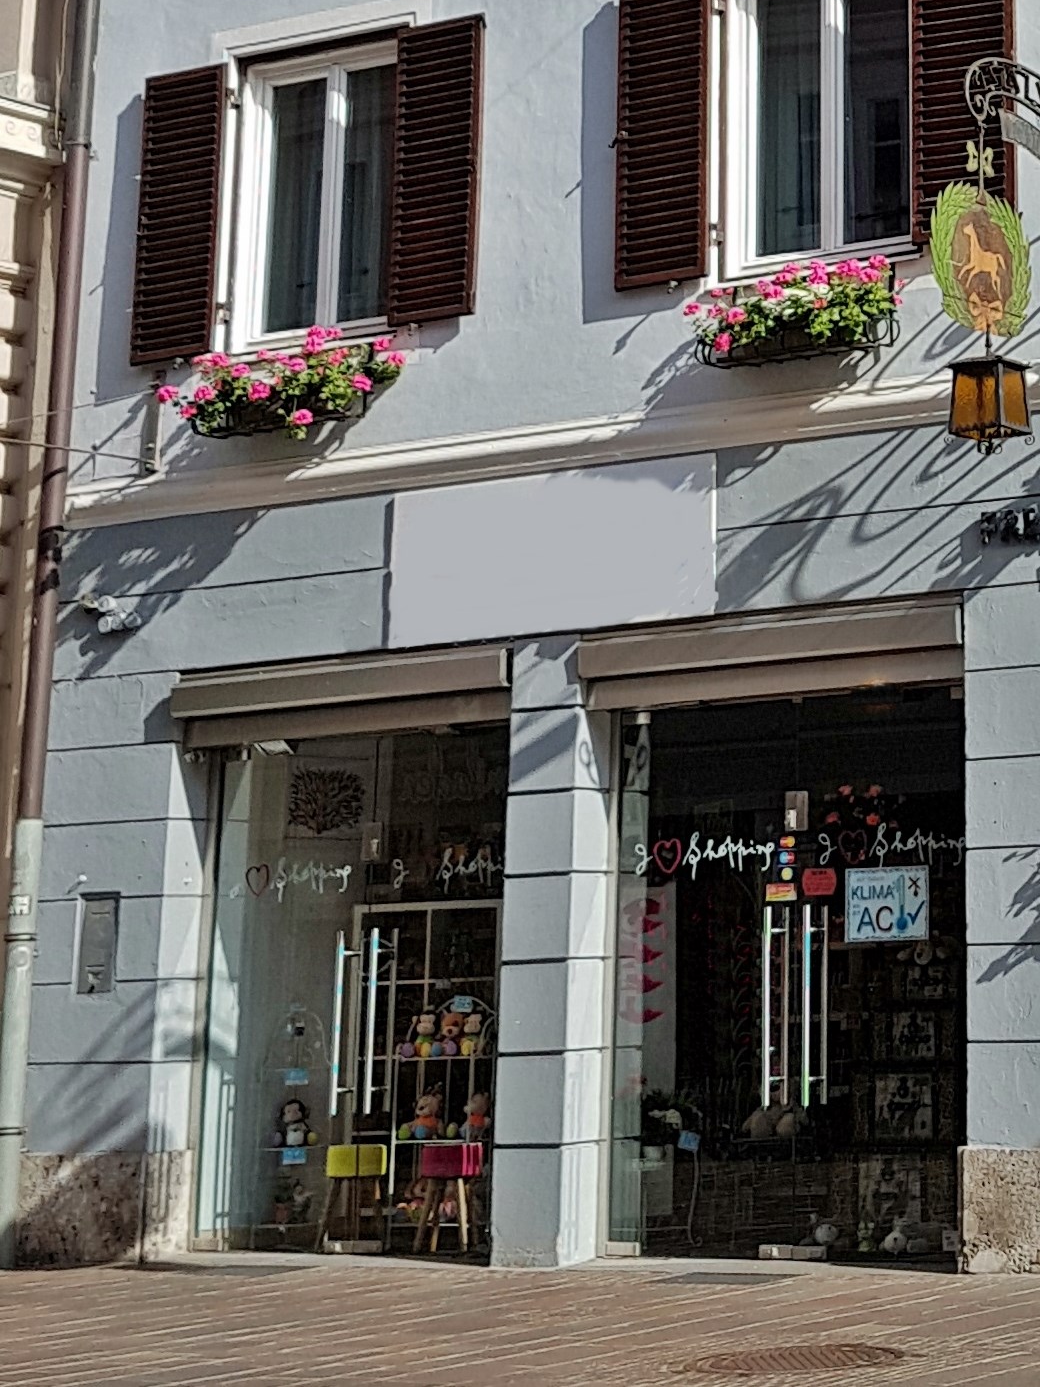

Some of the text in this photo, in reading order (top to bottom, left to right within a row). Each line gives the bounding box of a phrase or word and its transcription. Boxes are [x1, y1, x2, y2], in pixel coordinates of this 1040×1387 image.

[682, 831, 775, 881] Shopping
[869, 822, 966, 869] Shopping
[851, 884, 895, 901] KLIMA
[857, 905, 895, 934] AC
